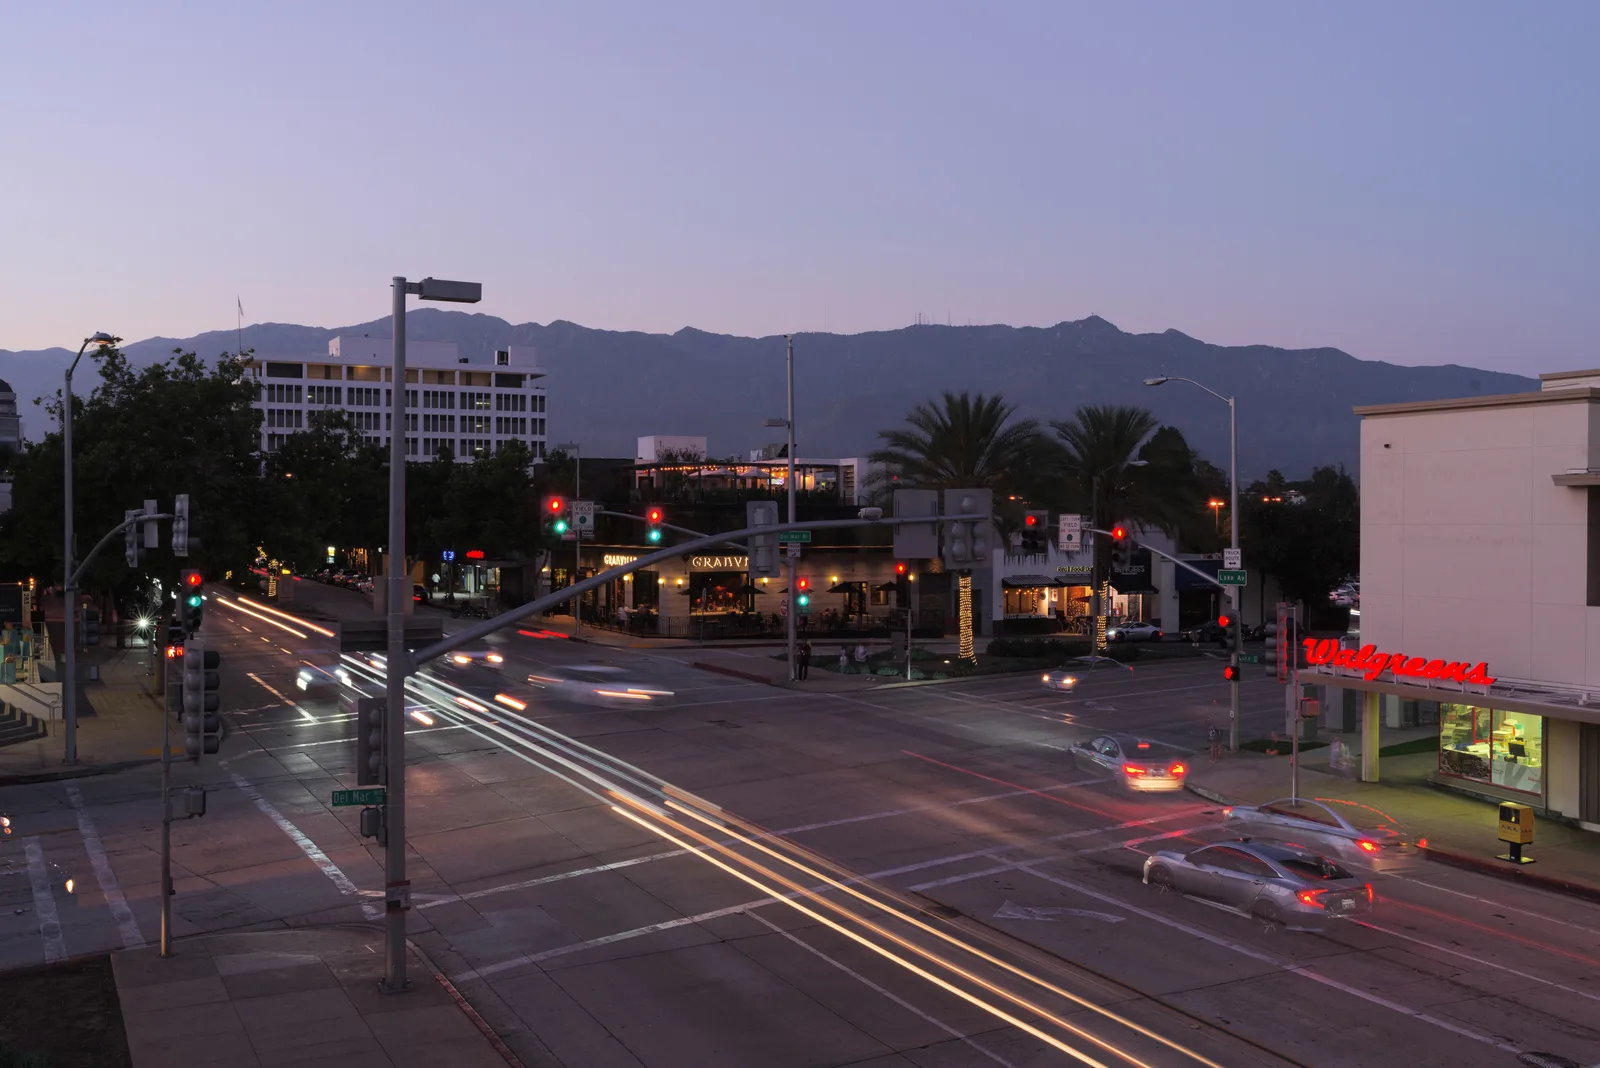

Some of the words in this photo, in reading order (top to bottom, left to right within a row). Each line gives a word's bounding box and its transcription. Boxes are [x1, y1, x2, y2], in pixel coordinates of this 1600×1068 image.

[692, 556, 750, 569] GRANVI
[1303, 637, 1497, 685] Walgreens
[333, 792, 349, 804] Del
[352, 790, 369, 803] Mar
